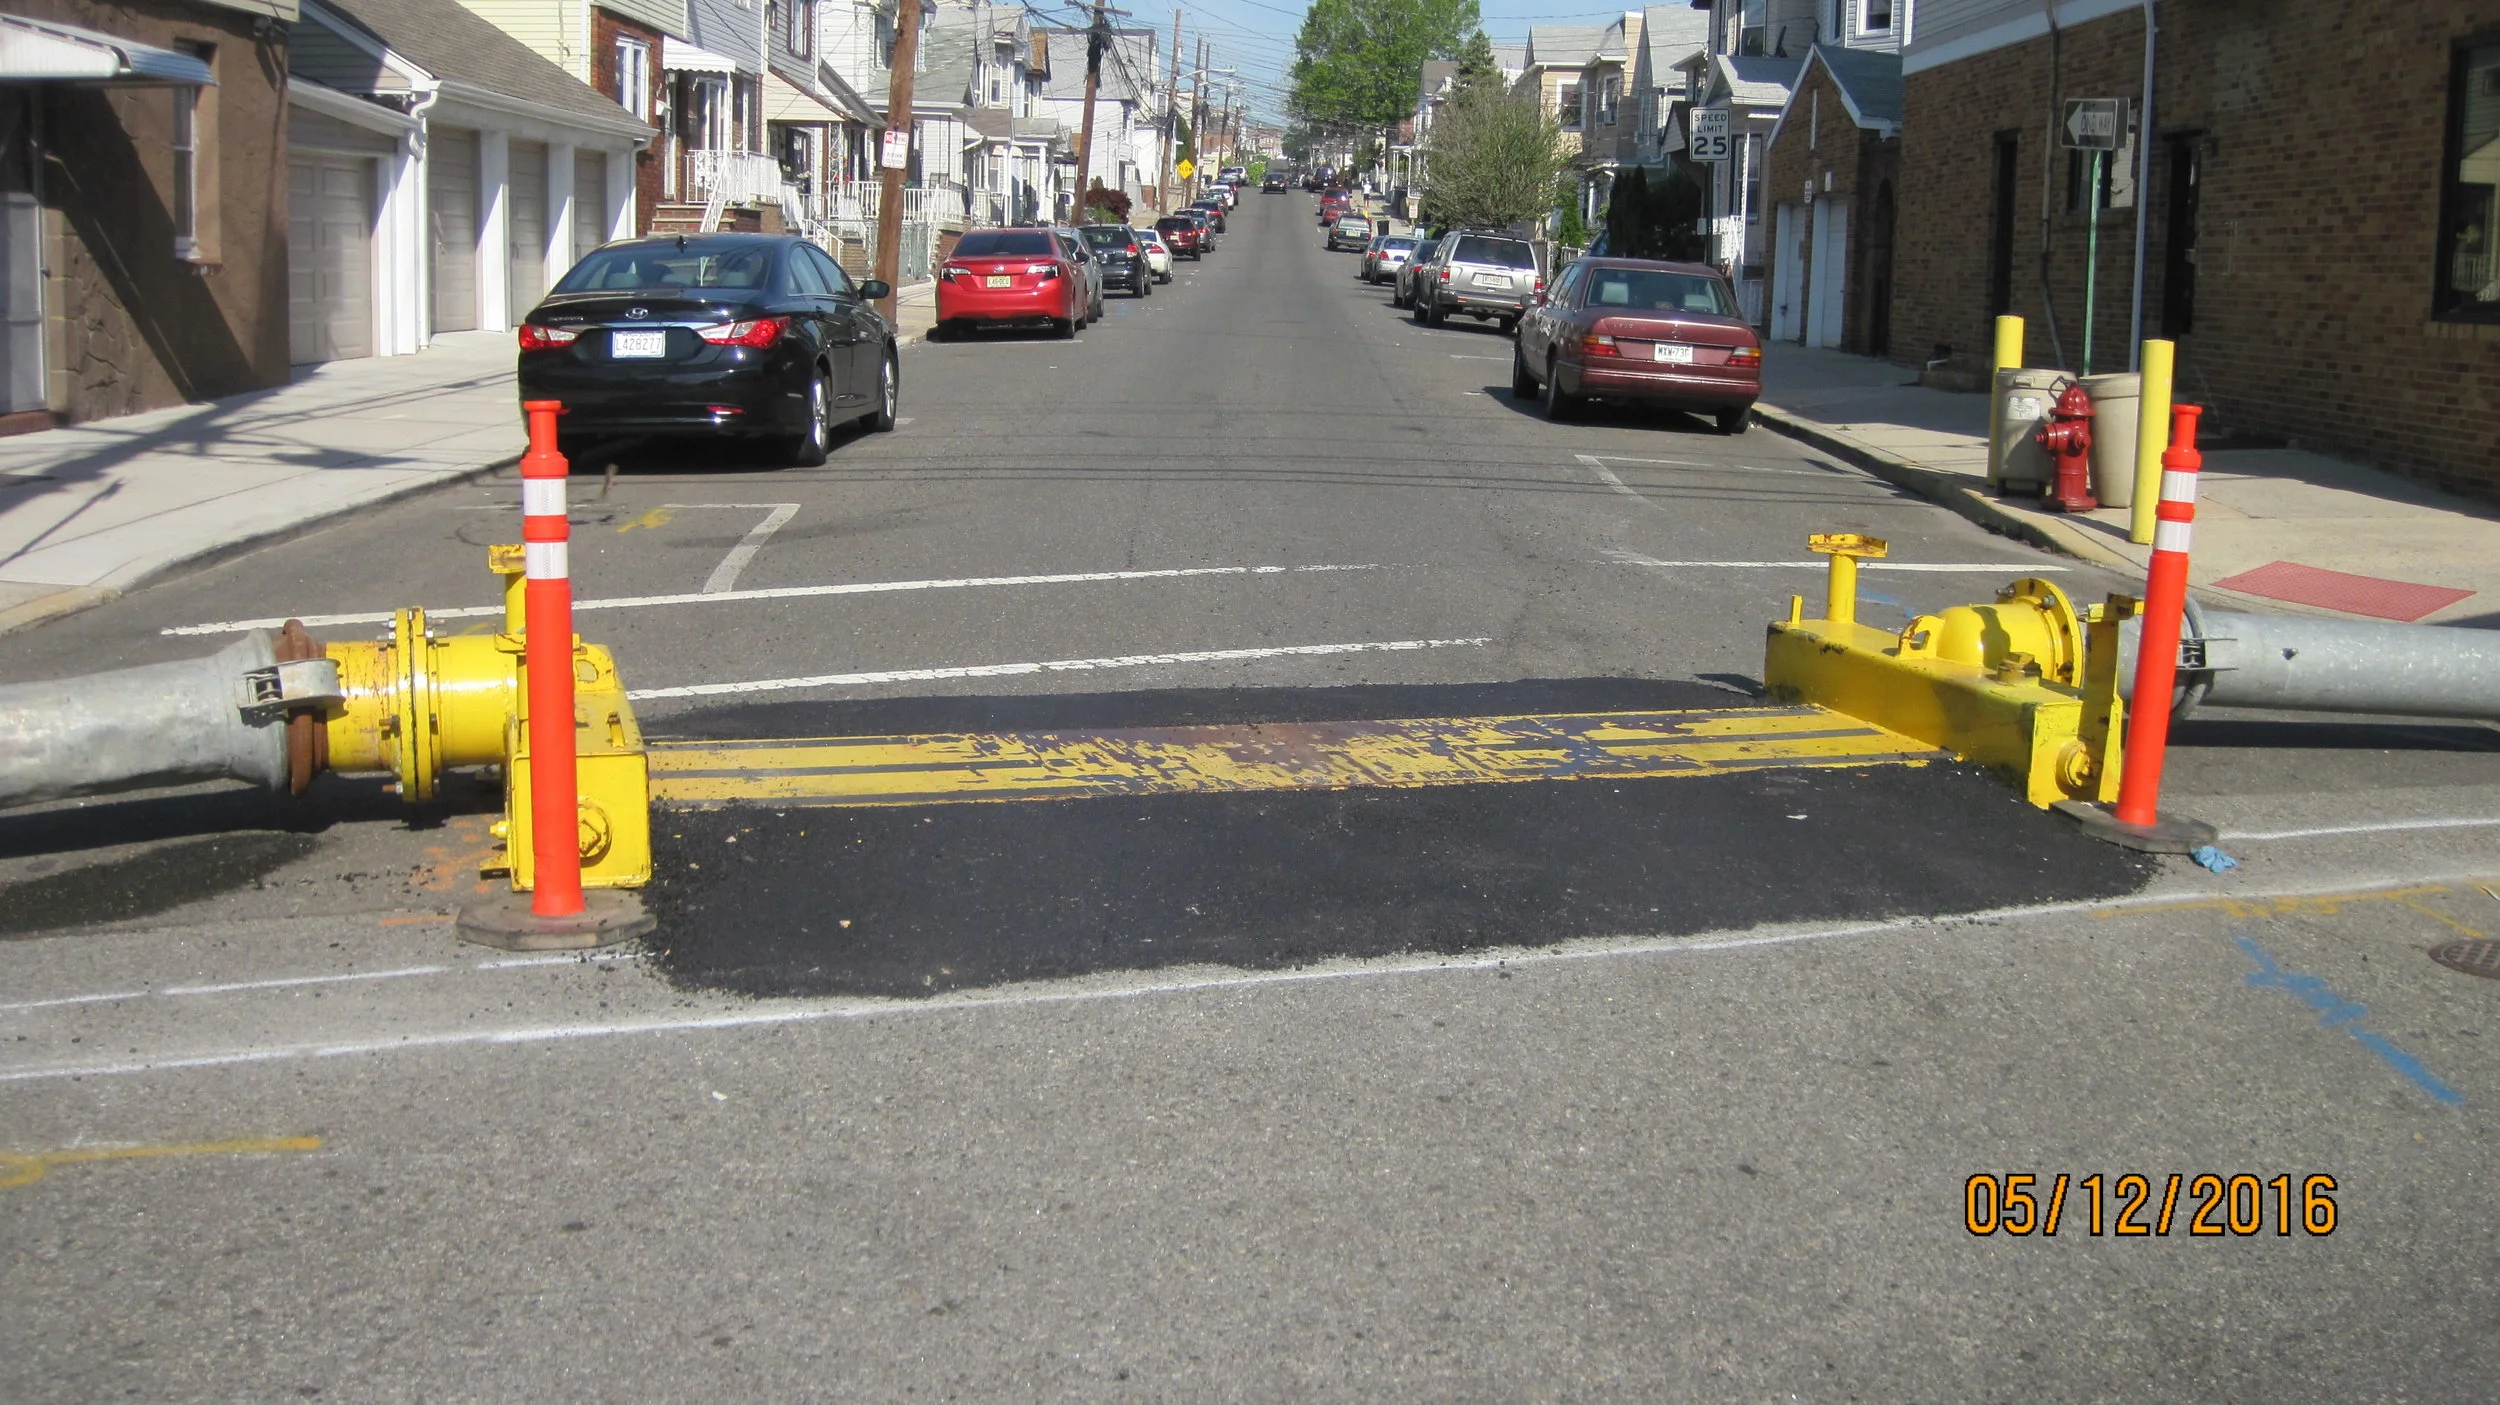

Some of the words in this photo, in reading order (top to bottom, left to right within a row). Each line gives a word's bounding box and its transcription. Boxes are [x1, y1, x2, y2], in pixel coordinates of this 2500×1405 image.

[1694, 113, 1727, 122] SPEED
[2080, 113, 2096, 133] ONE
[2097, 115, 2112, 133] WAY
[1697, 125, 1723, 133] LIMIT
[1694, 136, 1727, 155] 25
